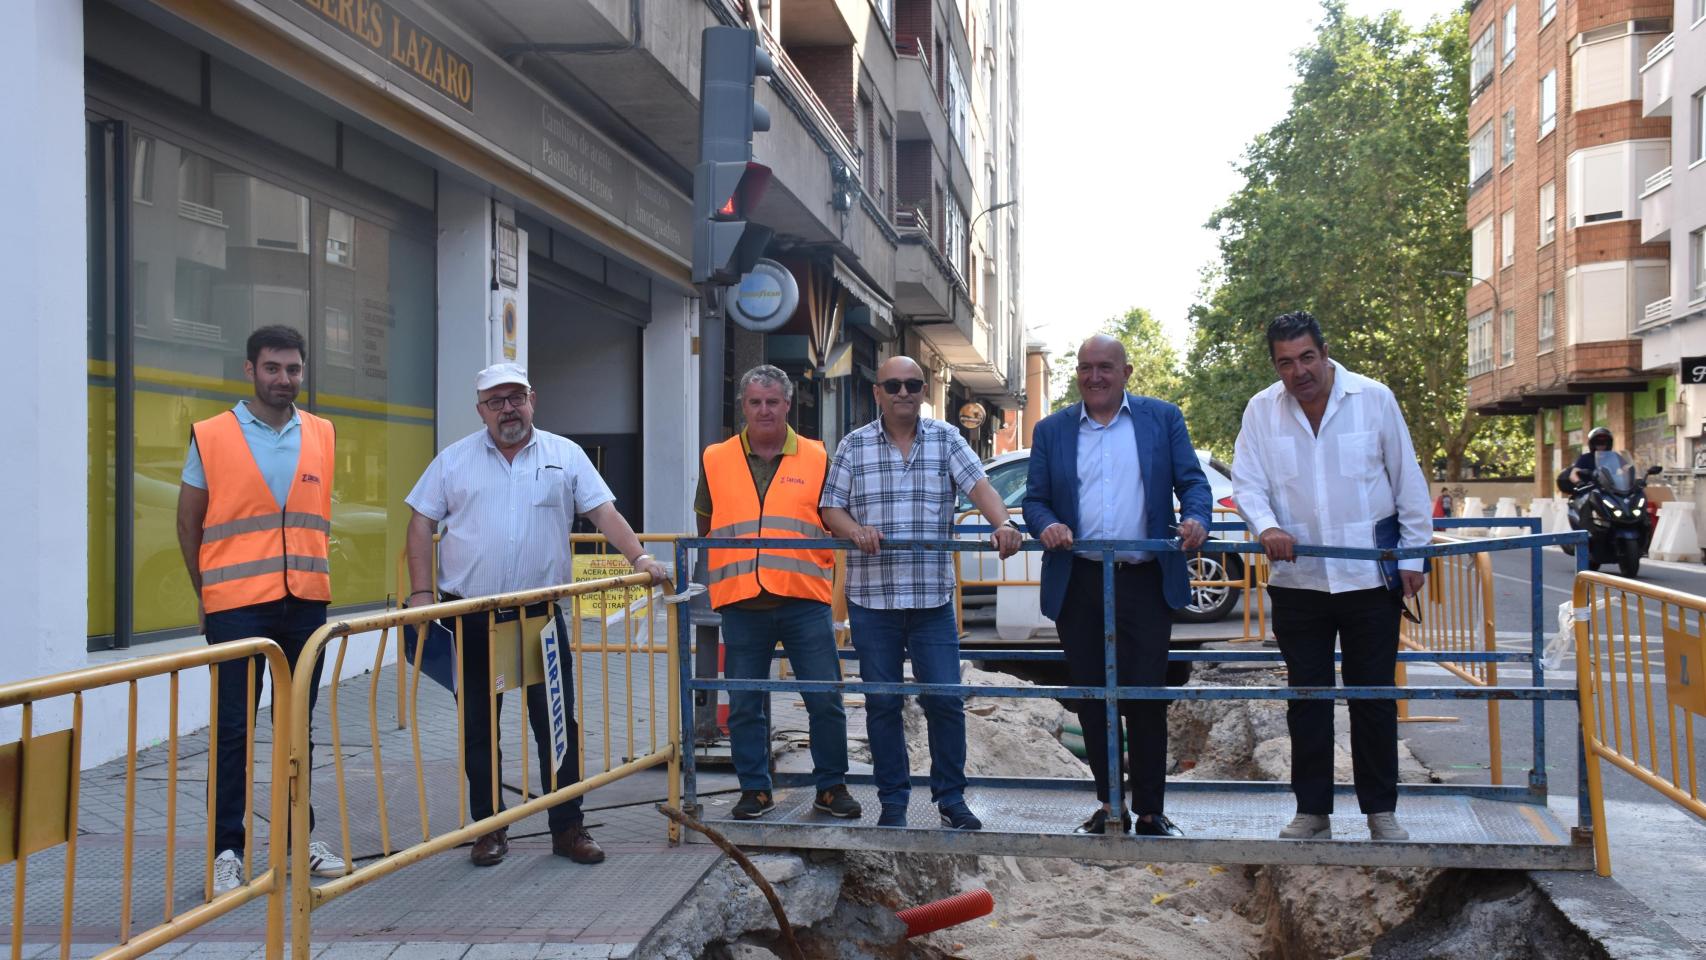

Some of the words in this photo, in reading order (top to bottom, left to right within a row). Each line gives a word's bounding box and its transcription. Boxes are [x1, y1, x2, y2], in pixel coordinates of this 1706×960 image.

[305, 0, 384, 49] ERES
[391, 16, 471, 103] LAZARO
[542, 136, 578, 181] Pastillas
[579, 163, 589, 188] de
[590, 169, 613, 203] frenos
[591, 558, 632, 567] ATENCIÓ
[545, 631, 565, 761] ZARZUELA
